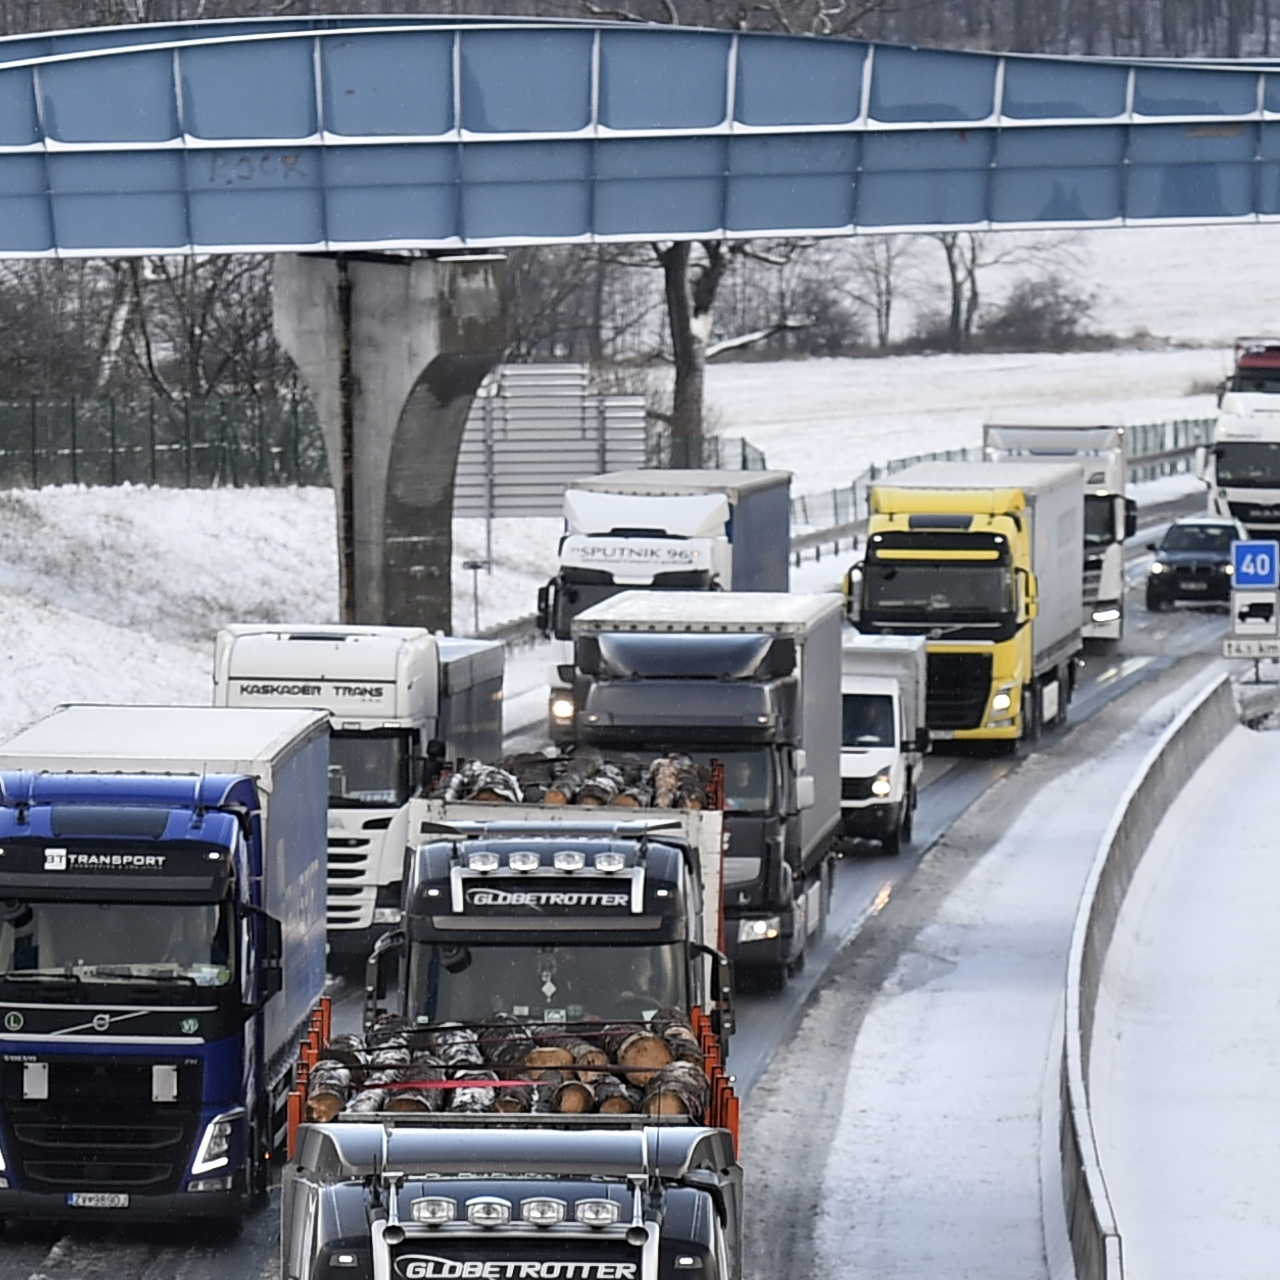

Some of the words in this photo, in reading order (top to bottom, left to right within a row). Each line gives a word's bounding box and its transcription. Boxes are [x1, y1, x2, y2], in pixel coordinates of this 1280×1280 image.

[579, 545, 662, 559] SPUTNIK
[1240, 552, 1271, 577] 40
[239, 684, 322, 696] KASKADER
[333, 686, 384, 697] TRANS
[68, 854, 167, 866] TRANSPORT
[473, 892, 629, 906] GLOBETROTTER
[405, 1261, 638, 1280] GLOBETROTTER
